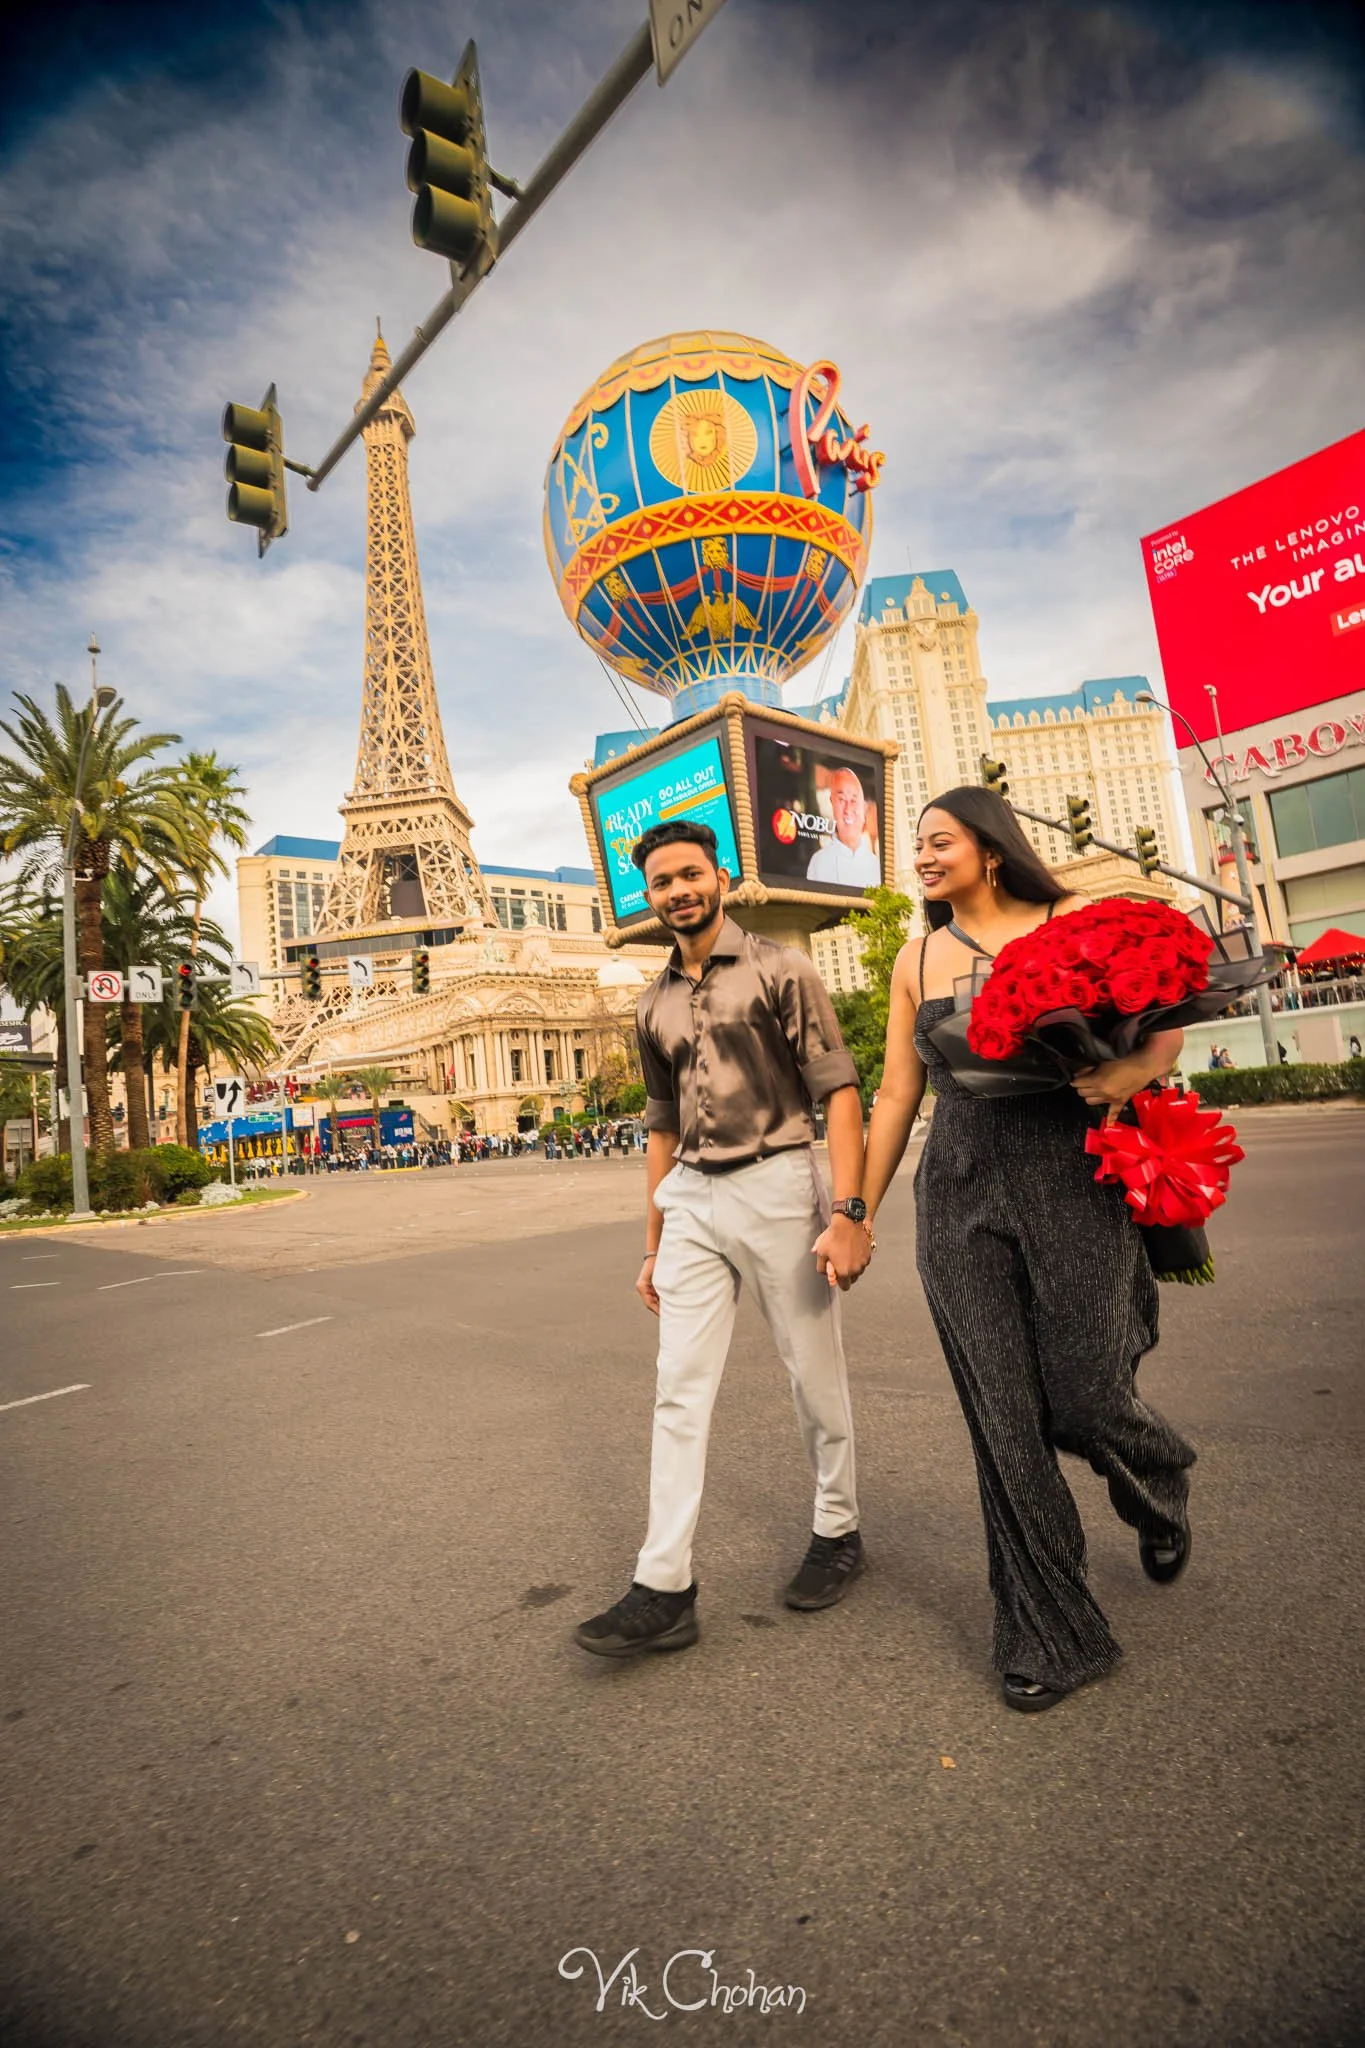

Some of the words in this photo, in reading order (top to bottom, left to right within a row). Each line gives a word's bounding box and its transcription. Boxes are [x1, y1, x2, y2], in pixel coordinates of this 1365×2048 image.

[789, 360, 886, 499] Paris
[1152, 535, 1187, 564] intel
[1231, 546, 1267, 570] THE
[1275, 505, 1359, 551] LENOVO
[1247, 568, 1325, 614] Your
[659, 785, 673, 801] GO
[676, 776, 693, 794] ALL
[694, 765, 714, 785] OUT
[607, 796, 654, 833] READY
[789, 810, 836, 834] NOBU
[622, 821, 643, 843] TO
[135, 991, 158, 999] ONLY
[235, 984, 256, 992] ONLY
